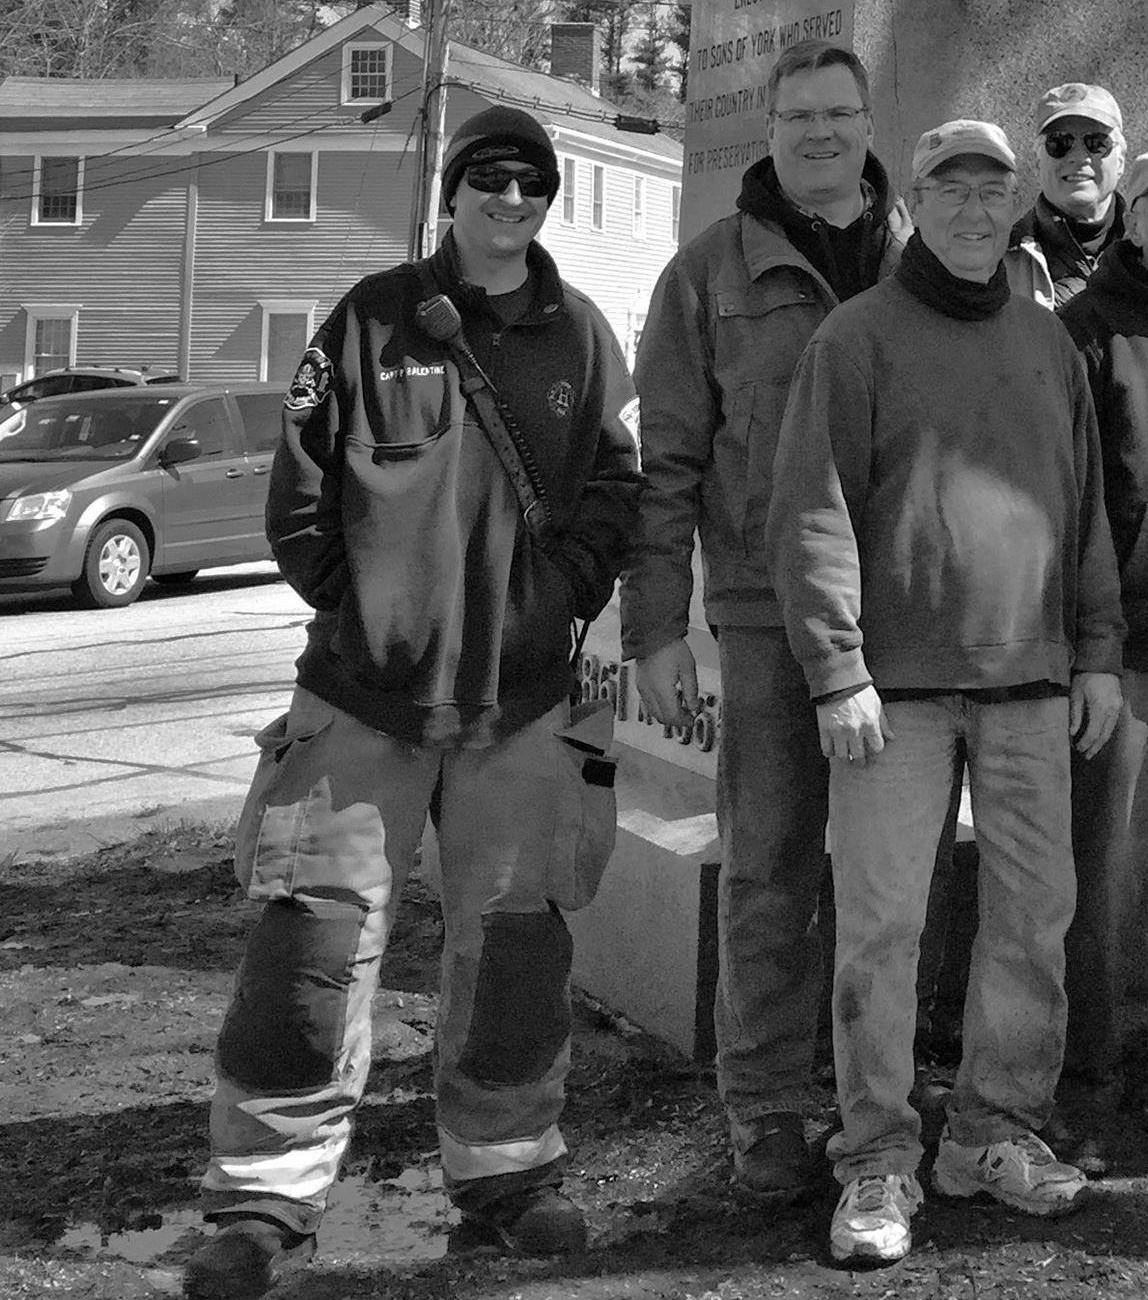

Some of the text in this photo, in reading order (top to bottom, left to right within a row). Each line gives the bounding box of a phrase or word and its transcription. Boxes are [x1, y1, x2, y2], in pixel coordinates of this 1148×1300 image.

[698, 10, 842, 70] TO SONS OF YORK WHO SERVED
[689, 85, 767, 123] THEIR COUNTRY IN
[689, 152, 704, 174] FOR
